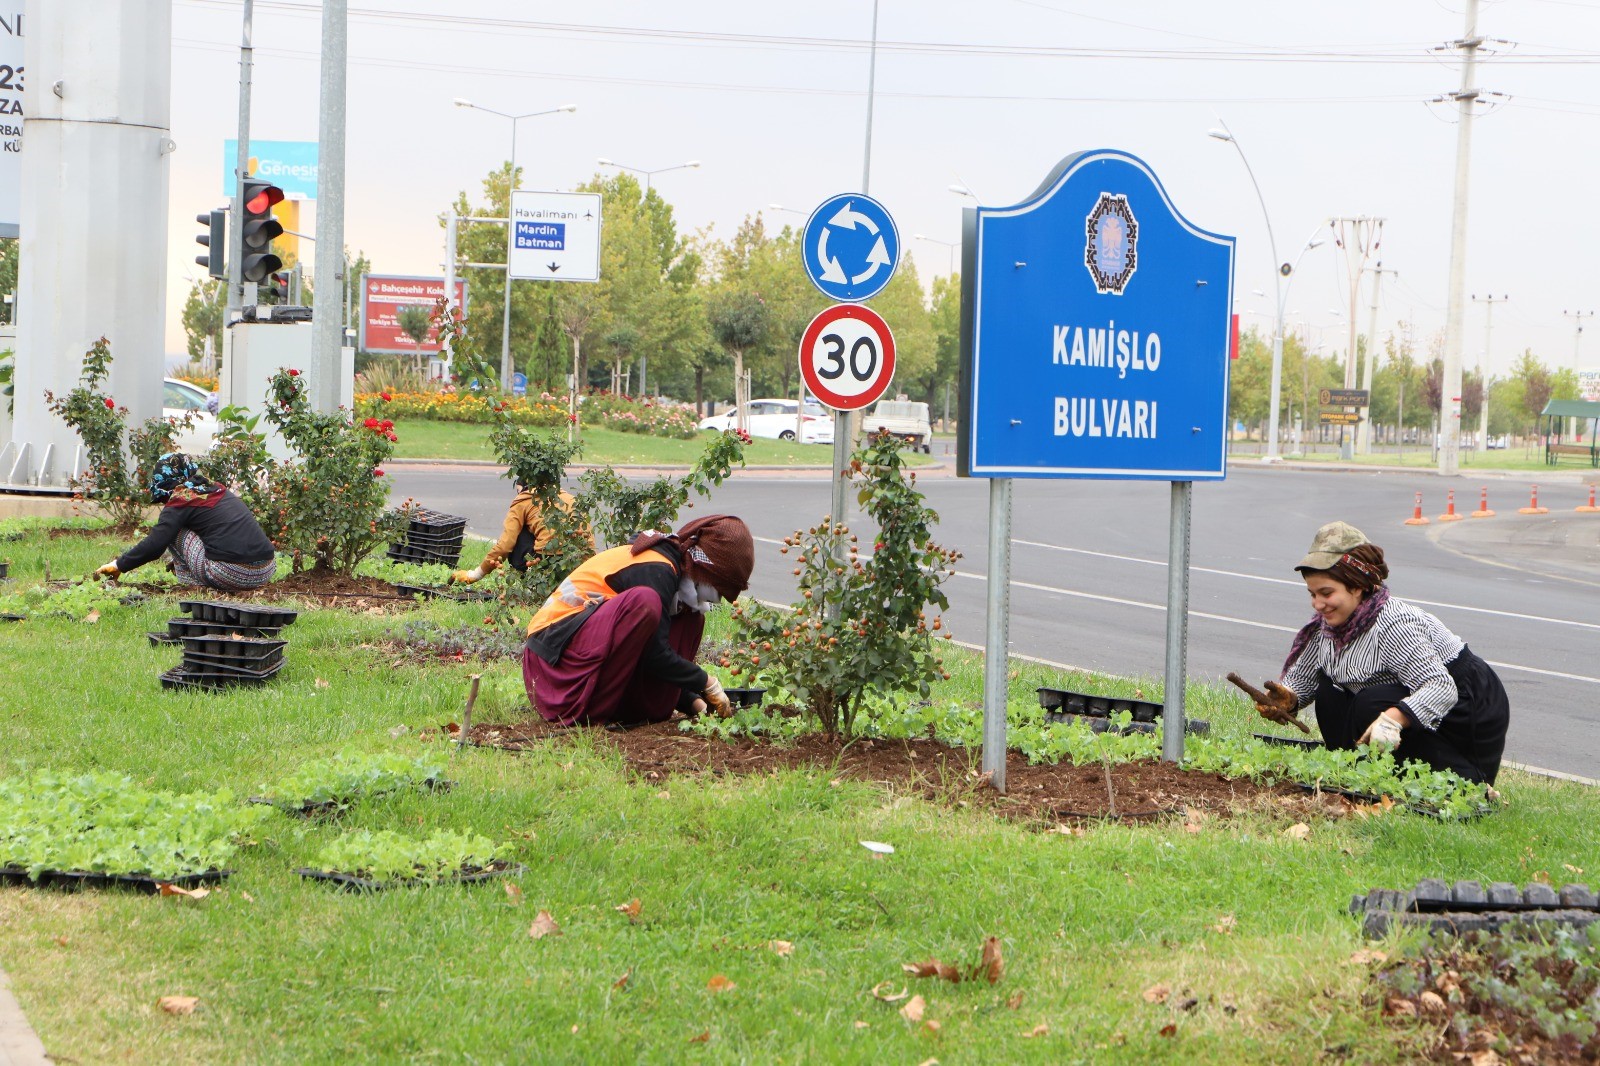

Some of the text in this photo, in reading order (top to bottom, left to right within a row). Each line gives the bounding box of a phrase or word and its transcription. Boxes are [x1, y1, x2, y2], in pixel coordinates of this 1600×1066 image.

[515, 208, 577, 219] Havalimanı
[517, 236, 562, 248] Batman
[518, 224, 557, 235] Mardin
[818, 334, 877, 382] 30
[1053, 319, 1161, 379] KAMİŞLO
[1054, 397, 1157, 439] BULVARI
